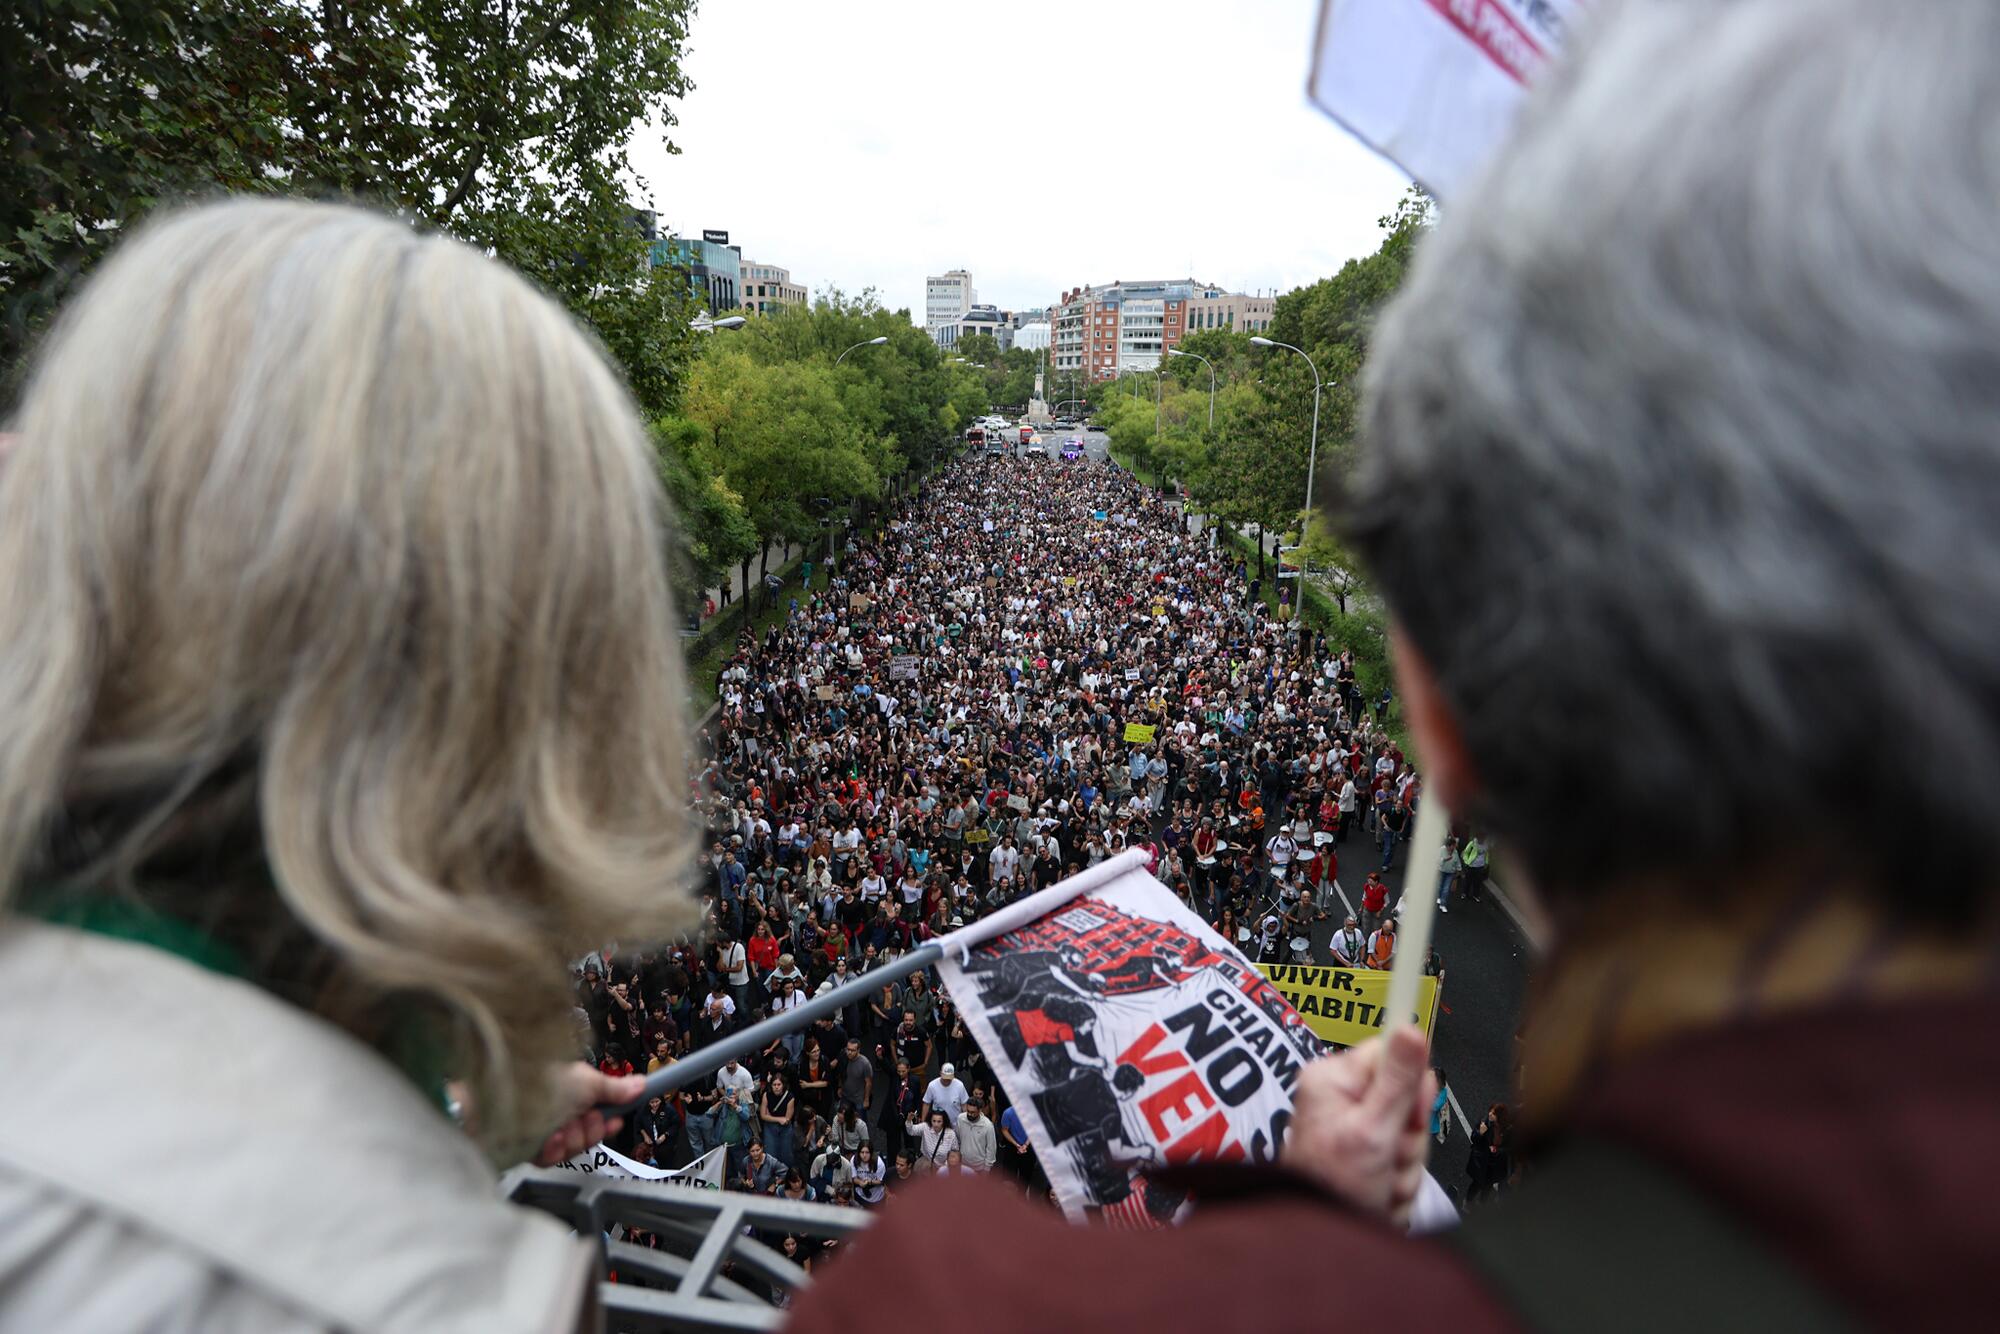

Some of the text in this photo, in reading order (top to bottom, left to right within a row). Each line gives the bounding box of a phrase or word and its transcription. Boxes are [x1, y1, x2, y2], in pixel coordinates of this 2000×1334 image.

[1268, 966, 1363, 996] VIVIR,
[1280, 990, 1419, 1027] HABITA
[1115, 1022, 1246, 1165] VEN
[1163, 1002, 1295, 1165] NO S
[1206, 989, 1303, 1106] CHAM
